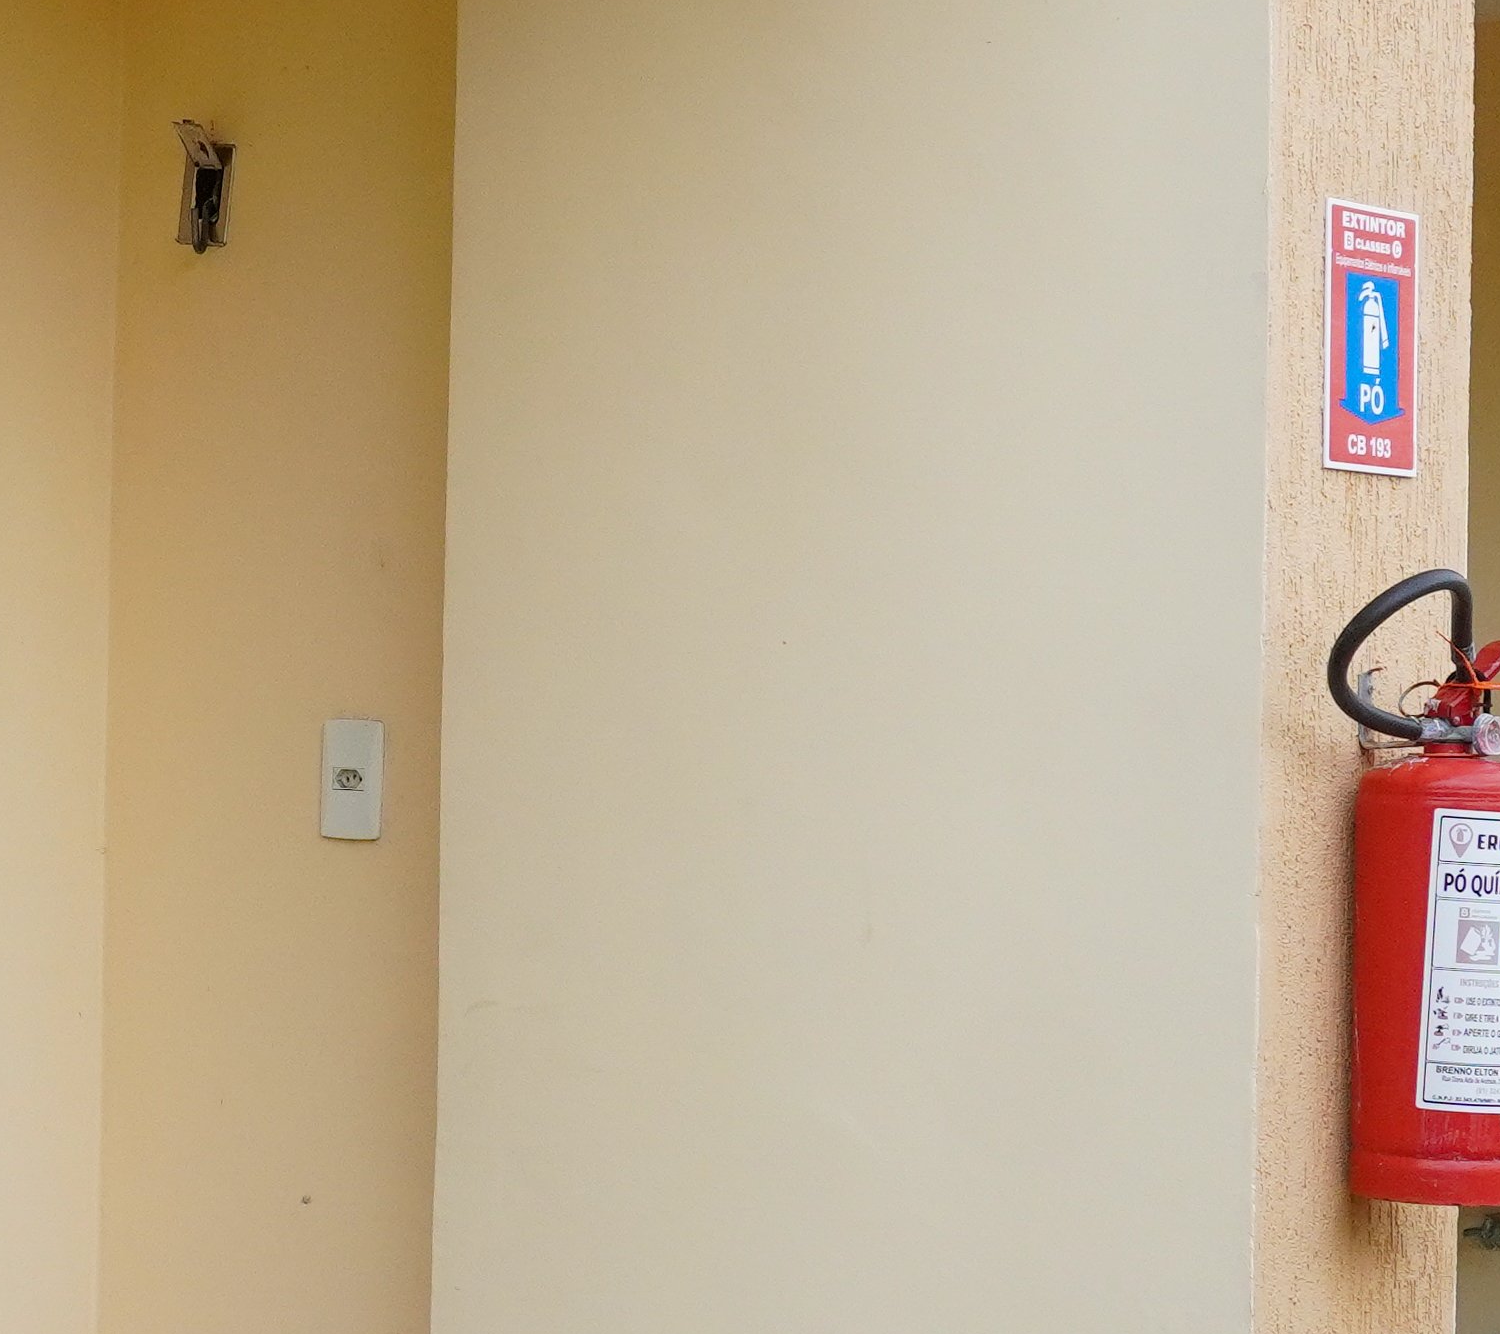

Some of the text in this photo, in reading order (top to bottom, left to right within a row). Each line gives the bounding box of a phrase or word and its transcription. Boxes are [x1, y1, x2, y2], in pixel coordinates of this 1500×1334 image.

[1342, 211, 1406, 238] EXTINTOR
[1355, 238, 1391, 254] CLASSES
[1359, 378, 1385, 415] PÓ
[1348, 434, 1391, 459] CB 193
[1443, 868, 1467, 893] PÓ
[1463, 1028, 1489, 1037] APERTE
[1435, 1065, 1471, 1075] BRENNO
[1474, 1067, 1498, 1076] ELTON
